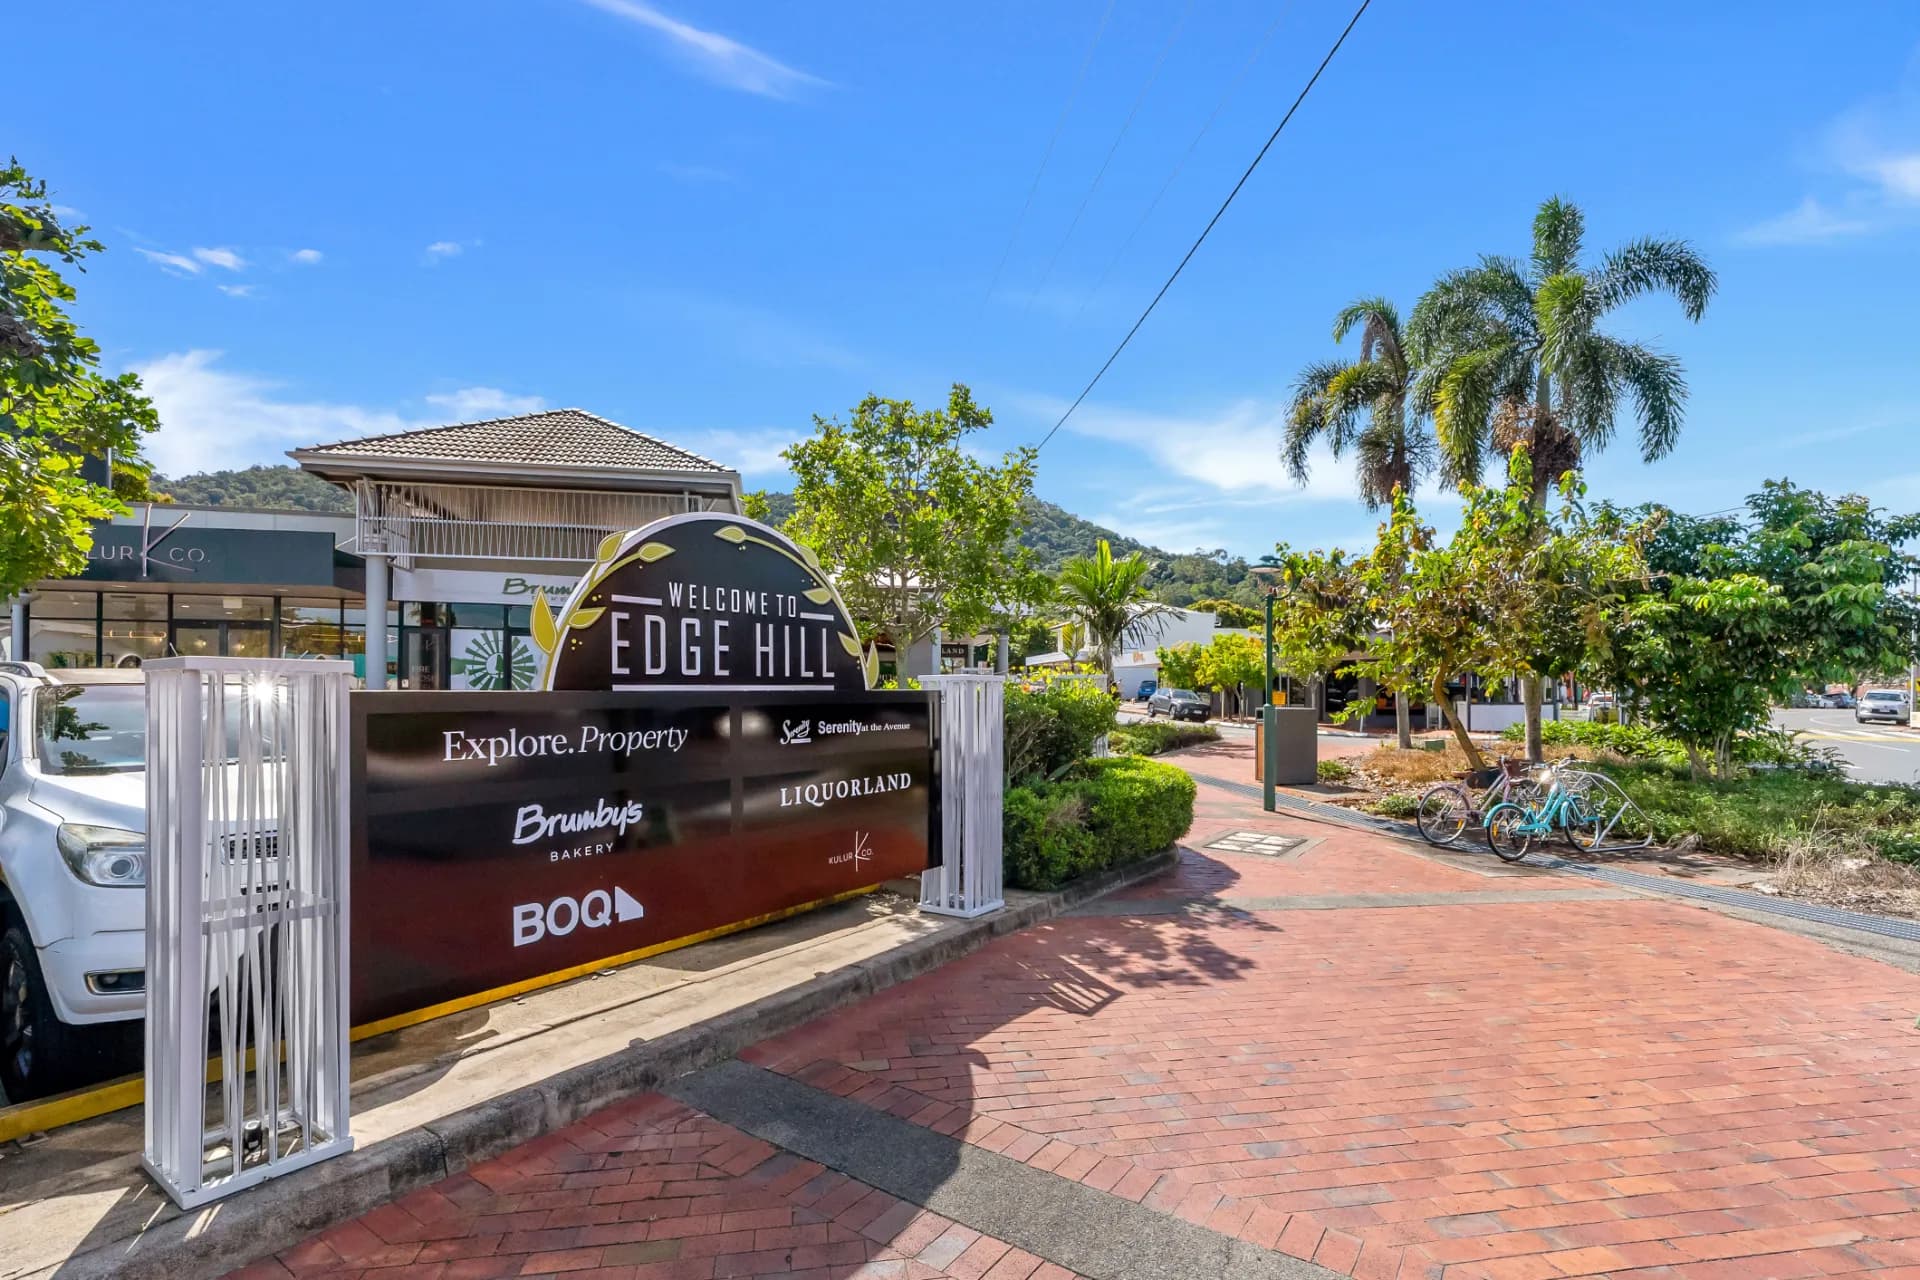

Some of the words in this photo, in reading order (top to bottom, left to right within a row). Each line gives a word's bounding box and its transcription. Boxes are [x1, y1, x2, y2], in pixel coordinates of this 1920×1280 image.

[668, 581, 768, 615] WELCOME
[776, 594, 796, 618] TO
[611, 611, 730, 676] EDGE
[755, 622, 835, 678] HILL
[442, 728, 574, 767] Explore.
[578, 726, 688, 758] Property
[818, 720, 862, 736] Serenity
[870, 723, 882, 731] the
[883, 722, 911, 731] Avenue
[780, 772, 911, 807] LIQUORLAND
[512, 798, 643, 845] Brumby's
[550, 843, 614, 862] BAKERY
[828, 852, 853, 865] KULUR
[513, 889, 612, 947] BOQ
